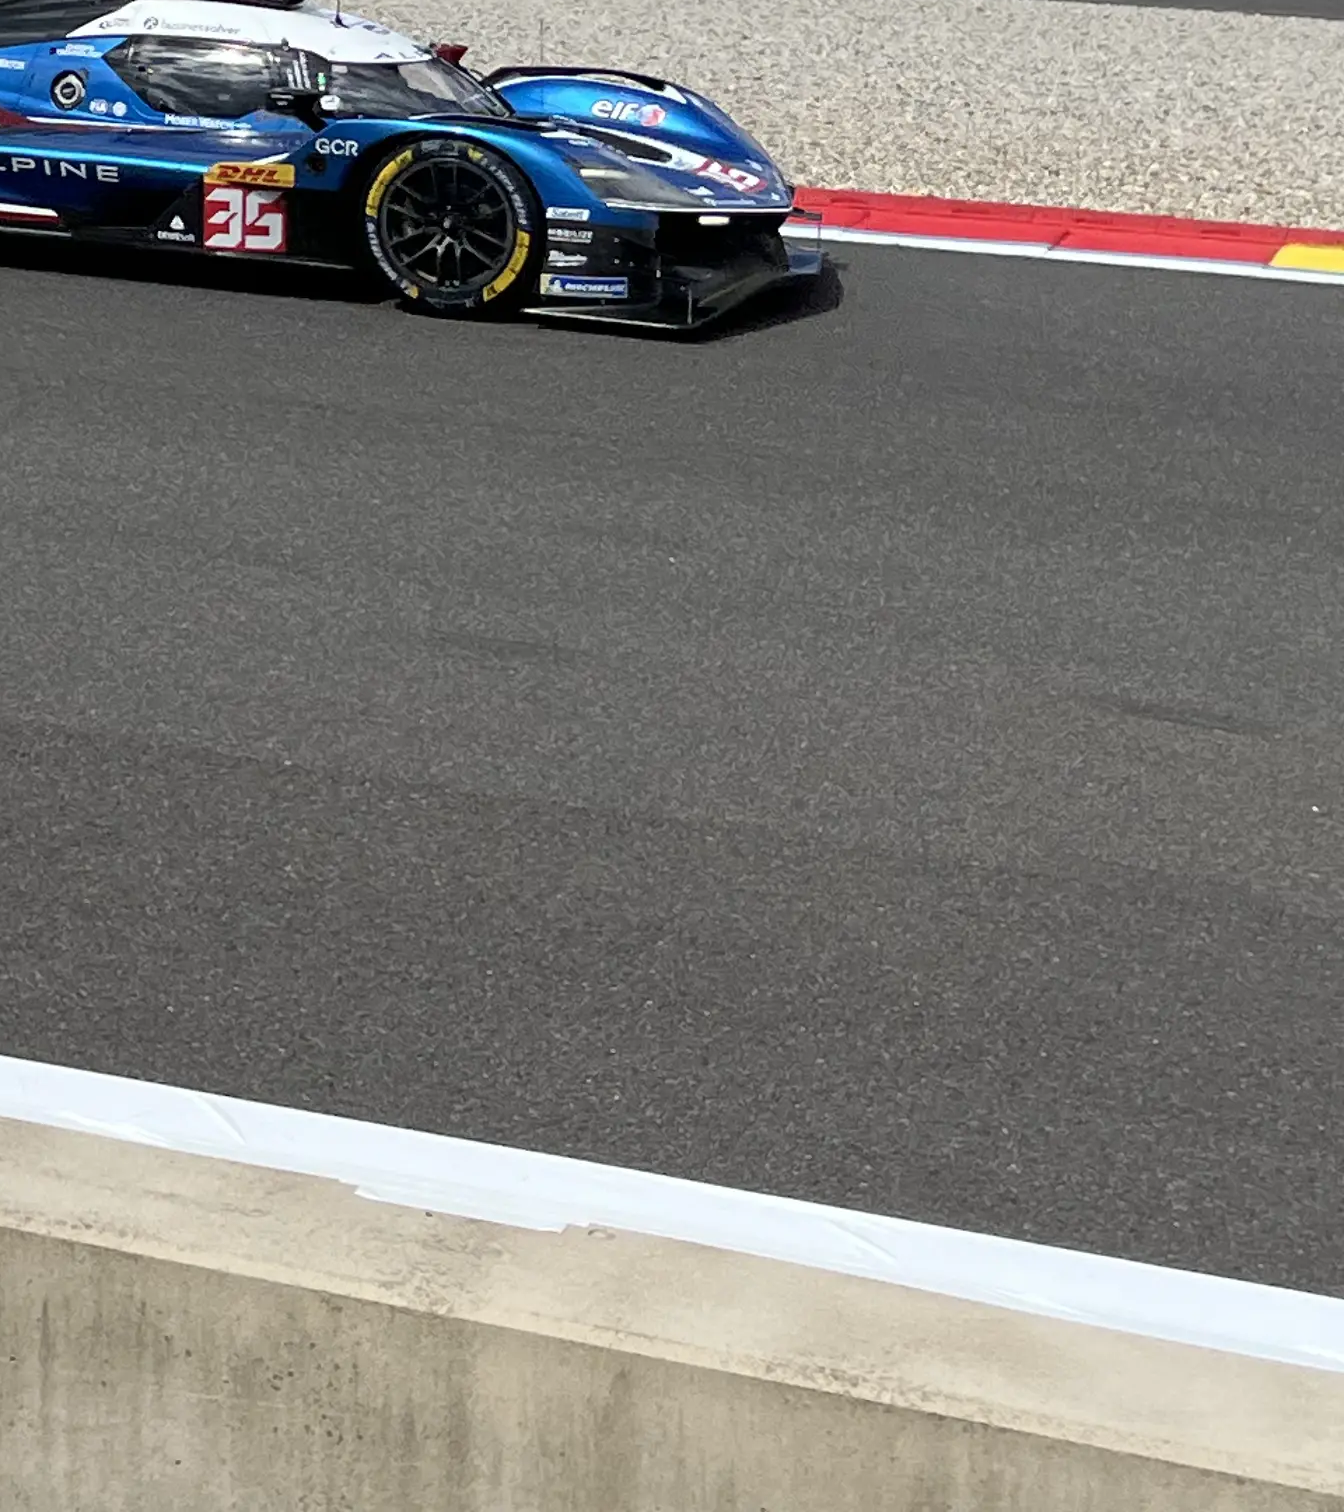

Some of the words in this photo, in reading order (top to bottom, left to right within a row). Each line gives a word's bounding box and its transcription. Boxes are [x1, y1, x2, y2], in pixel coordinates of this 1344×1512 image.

[591, 100, 640, 121] elf
[314, 137, 359, 157] GCR
[216, 164, 280, 184] DHL
[203, 187, 284, 251] 35
